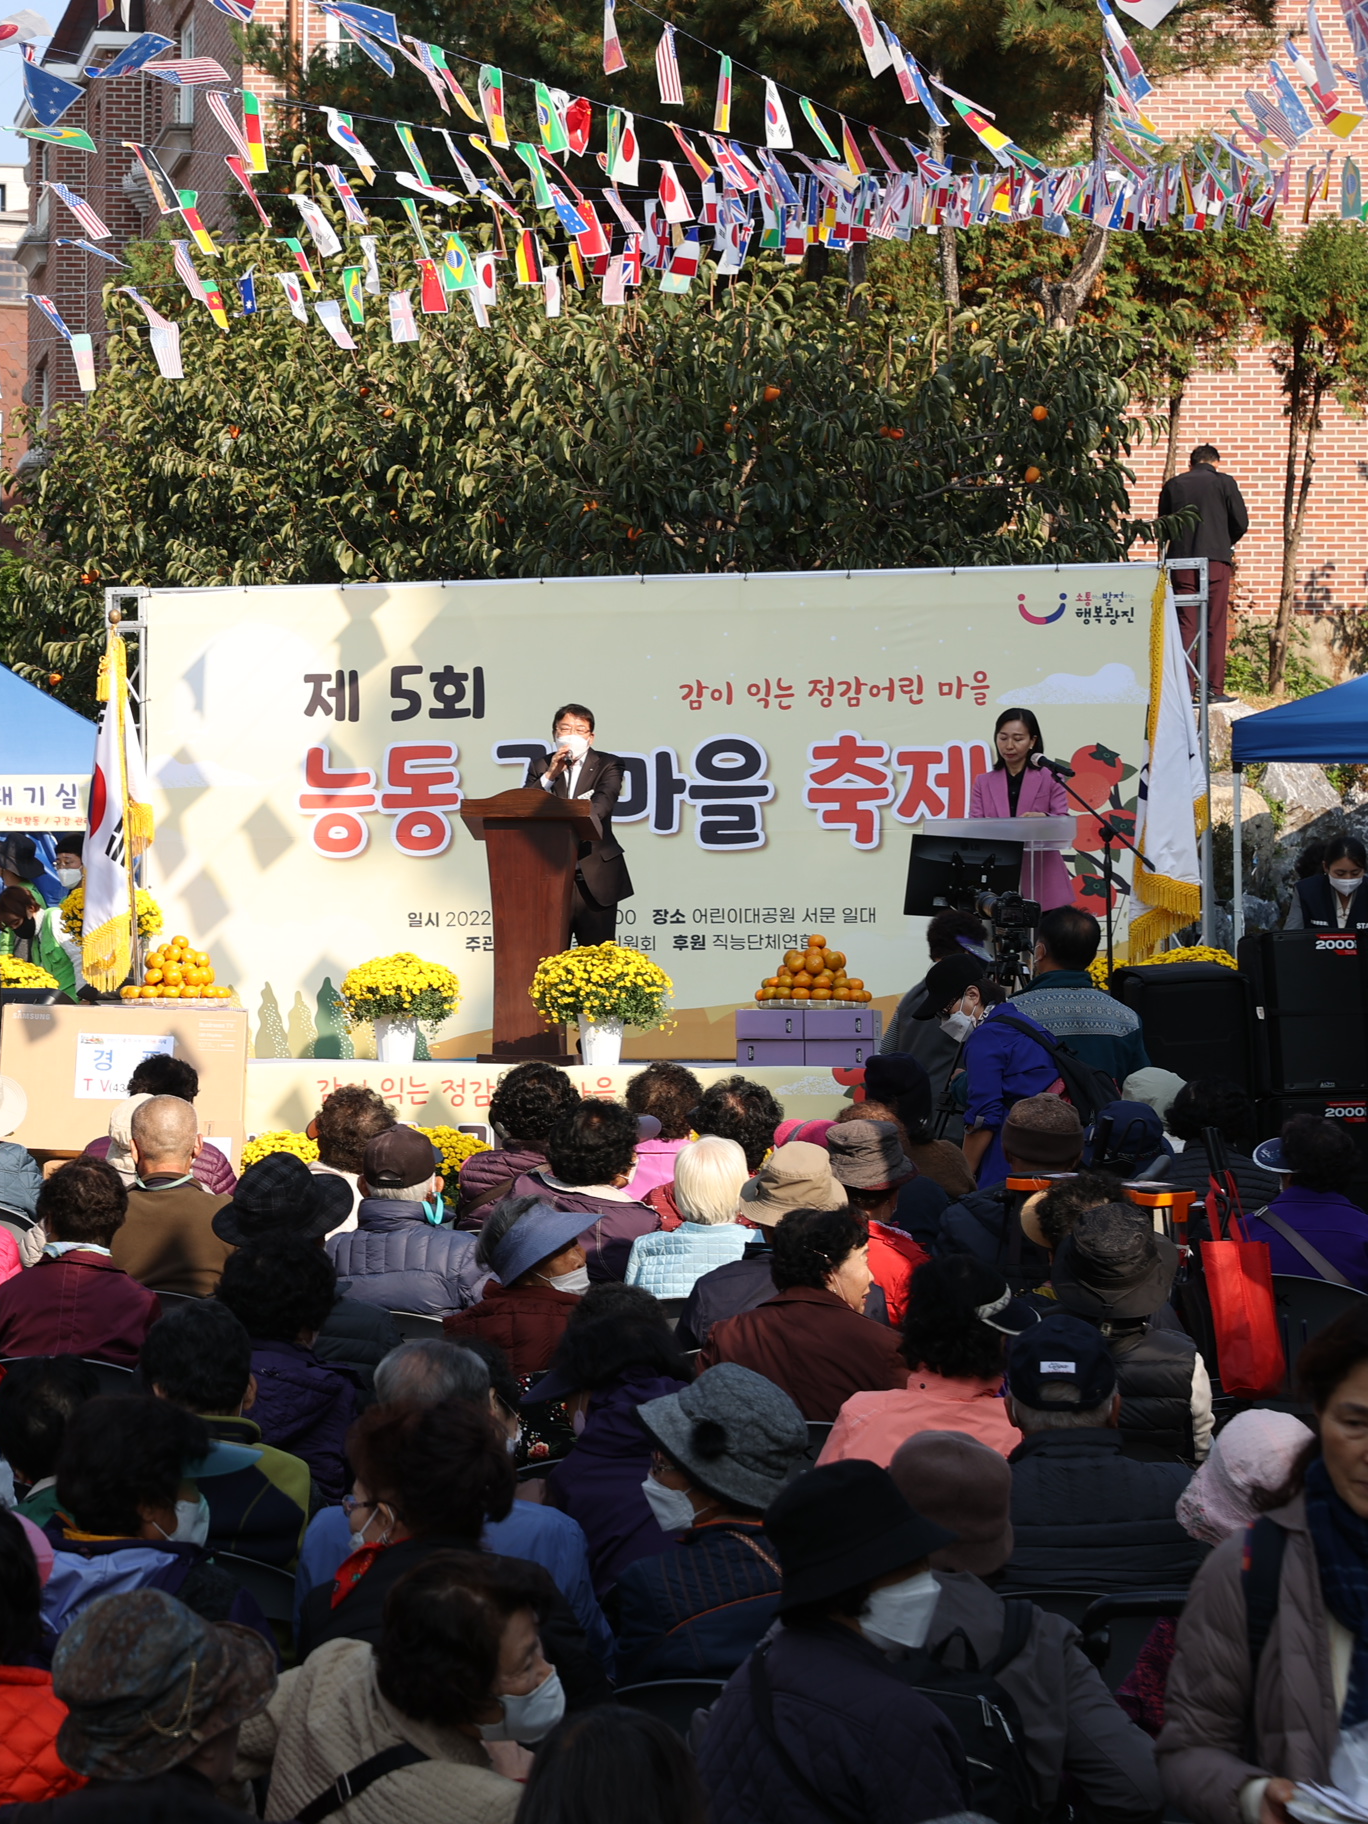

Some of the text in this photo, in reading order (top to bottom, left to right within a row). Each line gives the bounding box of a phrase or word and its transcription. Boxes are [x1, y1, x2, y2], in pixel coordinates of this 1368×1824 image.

[1075, 606, 1134, 625] 행복광진
[303, 665, 485, 722] 제 5회
[679, 671, 990, 710] 감이 익는 정감어린 마을
[298, 734, 988, 854] 능동 마을 축제
[408, 912, 439, 928] 일시
[652, 909, 686, 925] 장소
[692, 907, 795, 924] 어린이대공원
[801, 907, 836, 924] 서문
[842, 907, 877, 924] 일대
[615, 935, 656, 951] 원회
[673, 934, 706, 951] 후원
[1315, 940, 1355, 950] 2000
[13, 1012, 51, 1020] SAMSUNG
[381, 1076, 429, 1105] 익는
[1324, 1107, 1365, 1117] 2000
